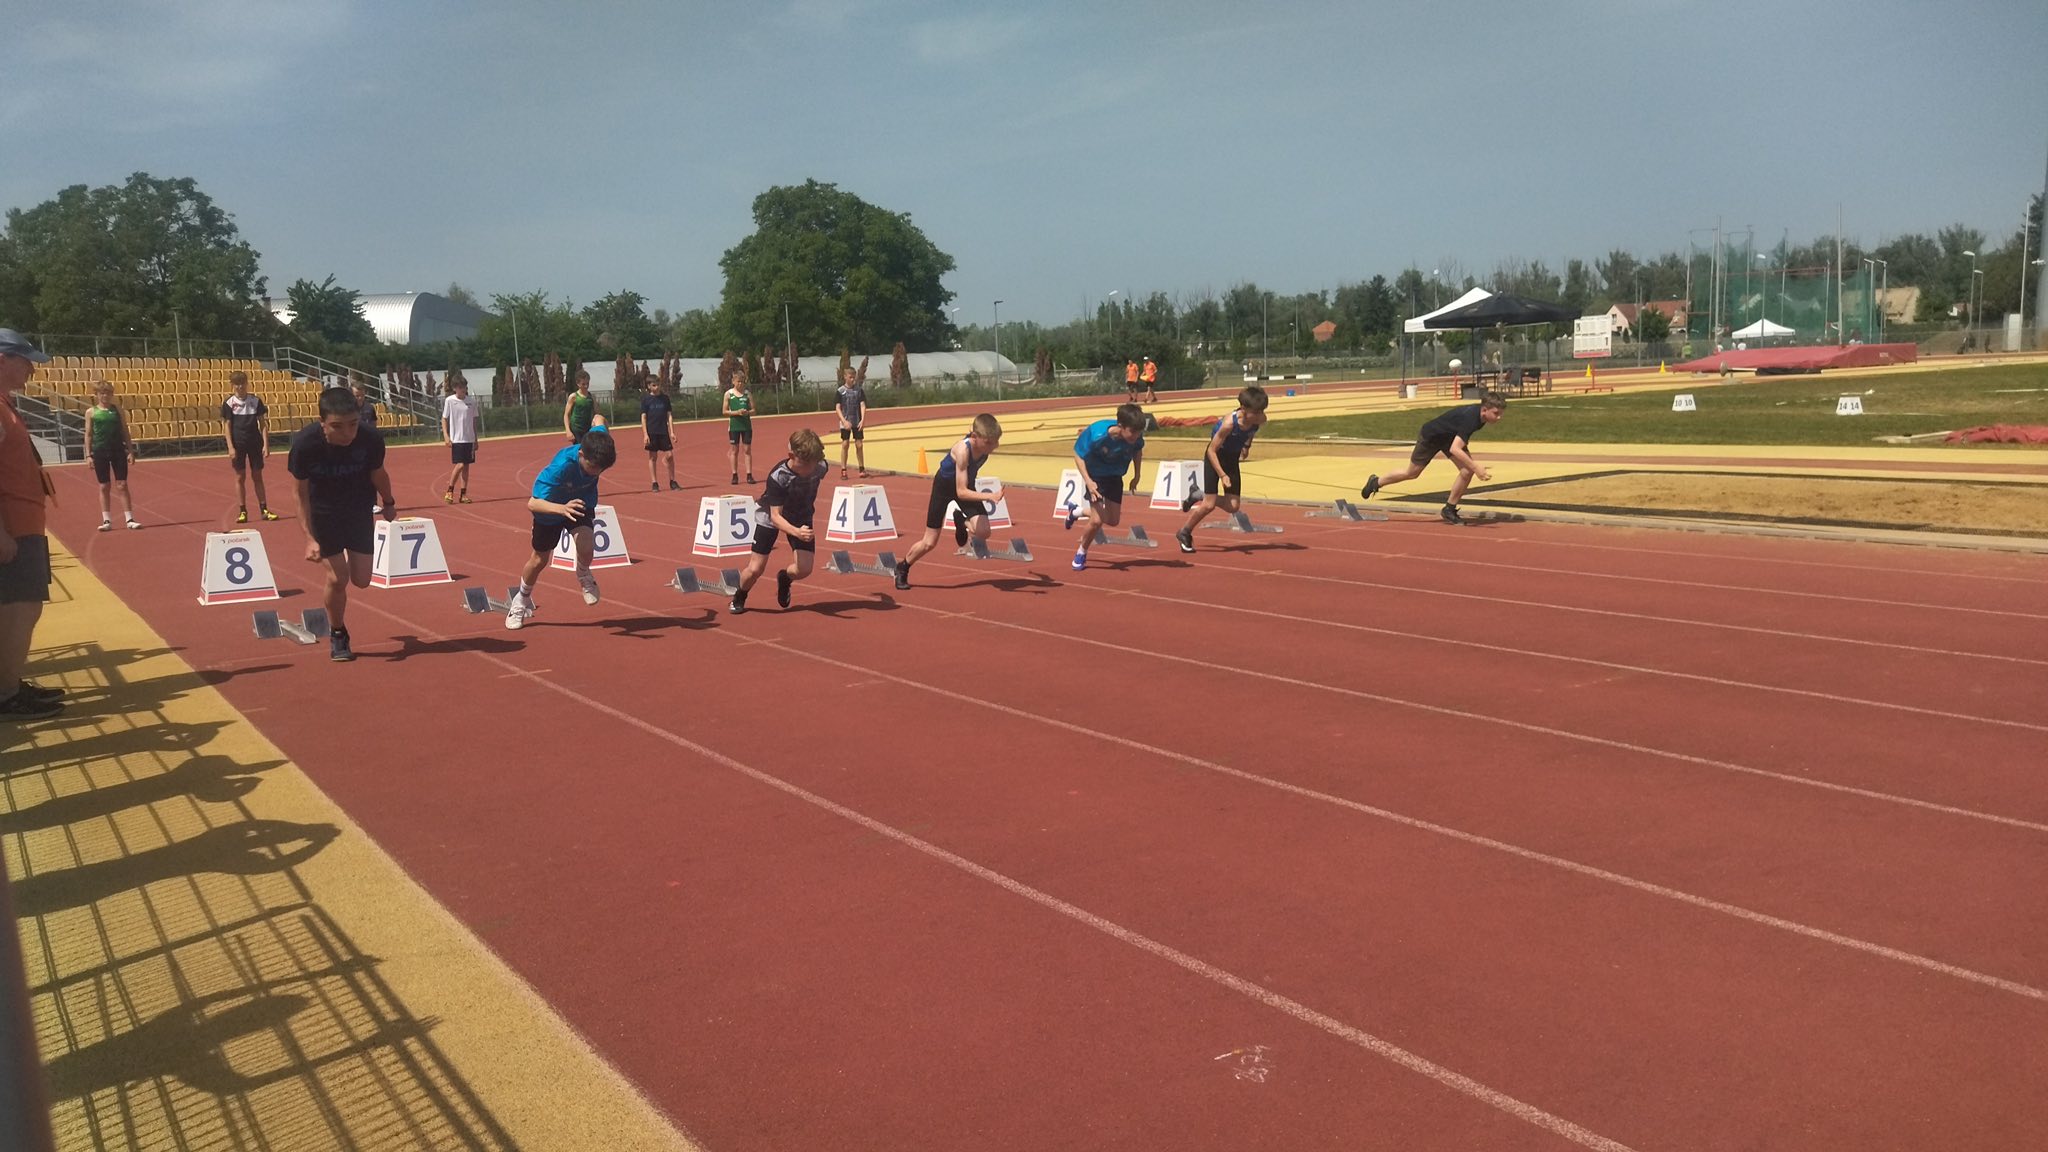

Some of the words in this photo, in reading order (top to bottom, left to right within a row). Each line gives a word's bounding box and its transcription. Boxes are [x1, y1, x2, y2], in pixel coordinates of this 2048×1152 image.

[1675, 399, 1683, 407] 10
[1684, 398, 1693, 407] 10
[1839, 401, 1848, 410] 14
[1850, 401, 1860, 410] 14
[1063, 479, 1076, 506] 2
[1163, 470, 1172, 497] 1
[702, 508, 714, 541] 5
[730, 507, 750, 540] 5
[835, 497, 848, 528] 4
[863, 497, 882, 527] 4
[592, 519, 610, 552] 6
[225, 546, 253, 585] 8
[376, 534, 386, 570] 7
[401, 532, 426, 570] 7
